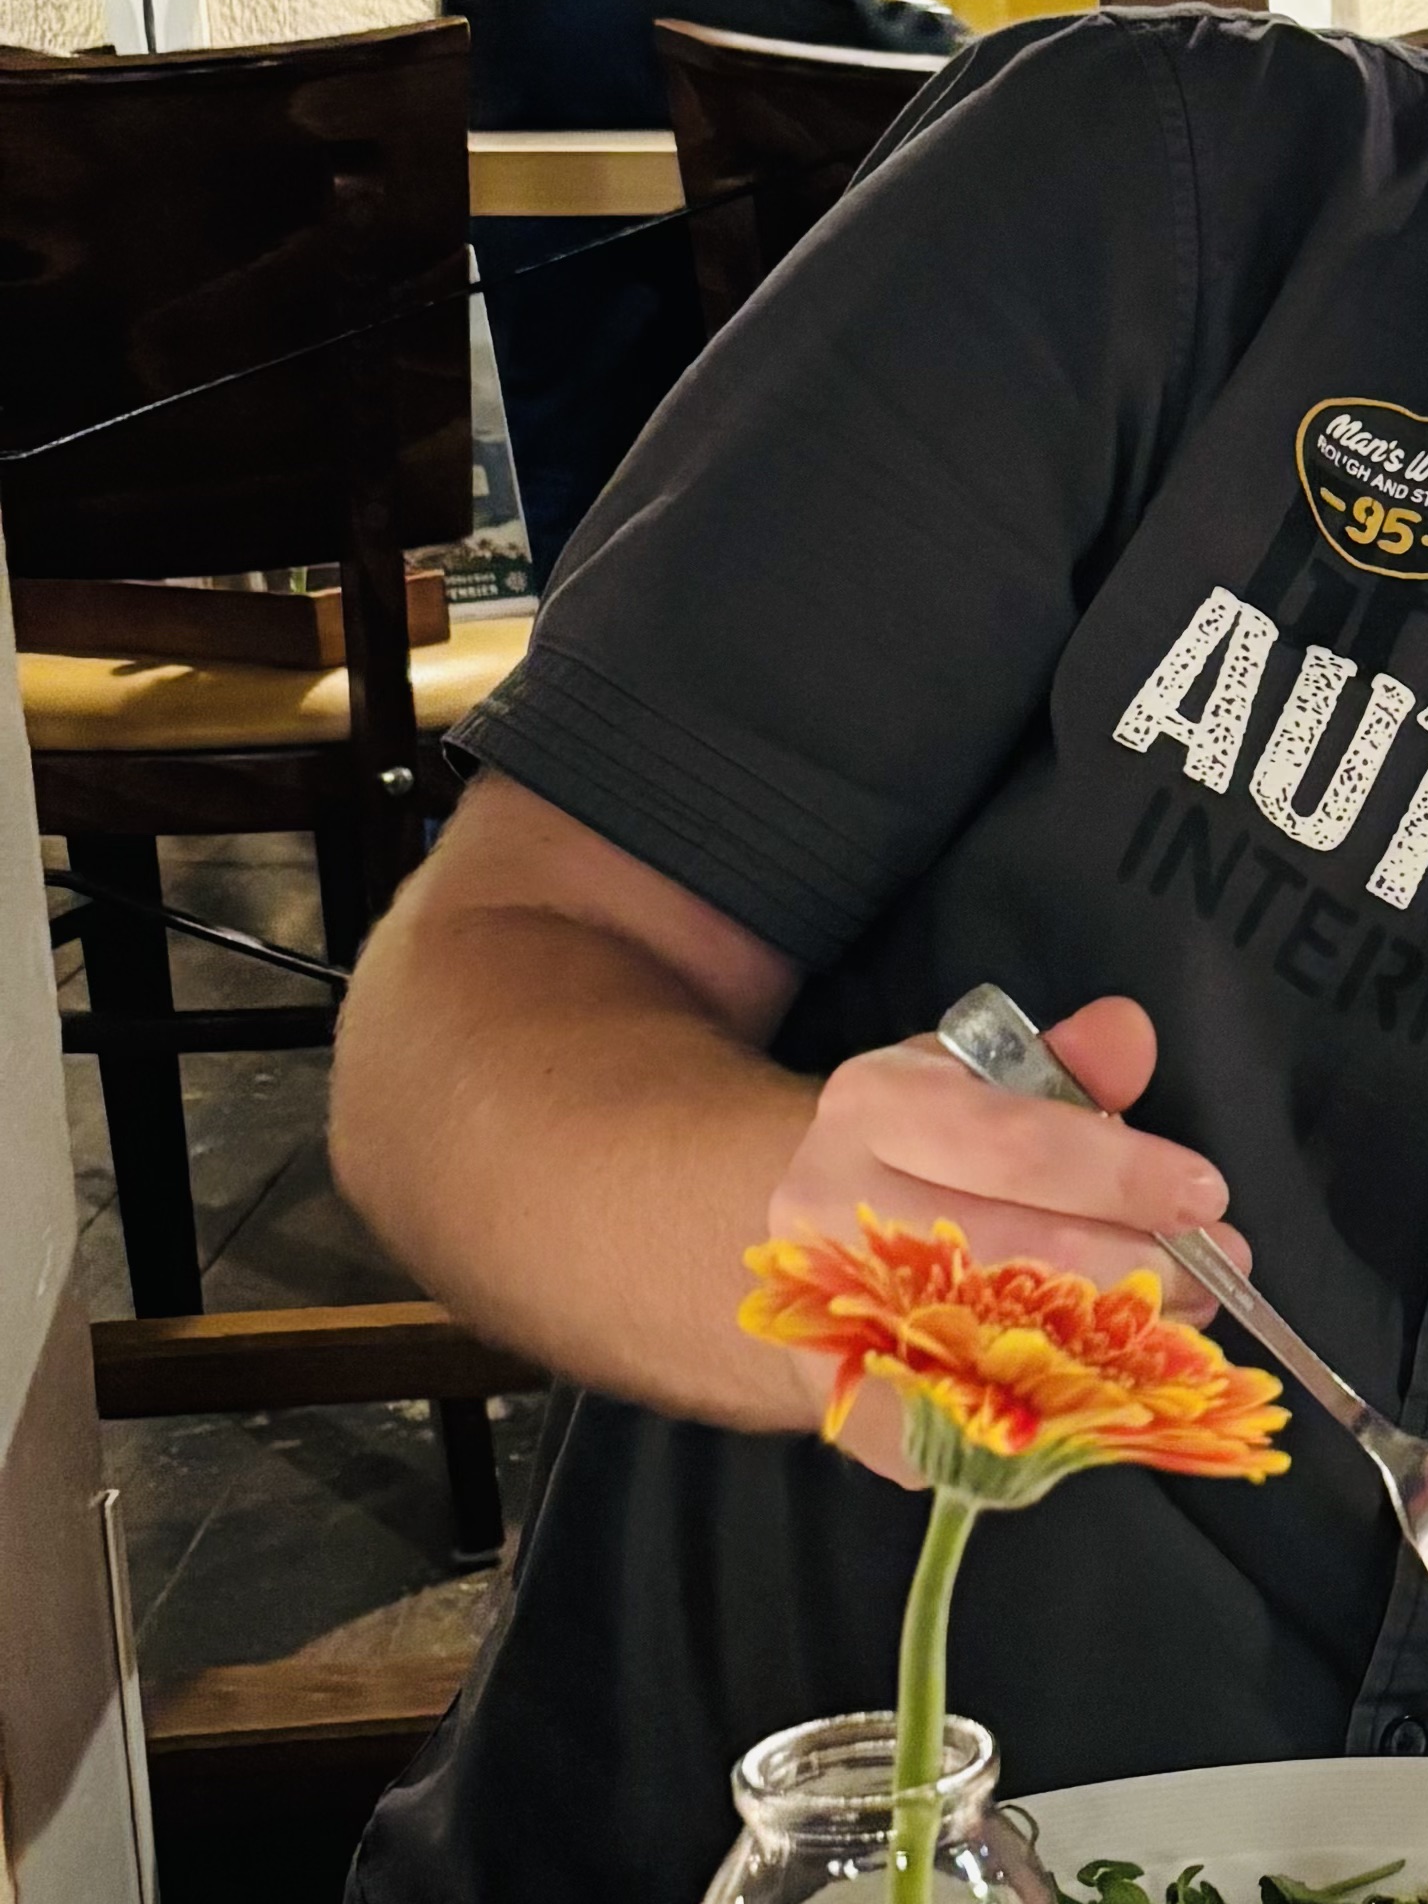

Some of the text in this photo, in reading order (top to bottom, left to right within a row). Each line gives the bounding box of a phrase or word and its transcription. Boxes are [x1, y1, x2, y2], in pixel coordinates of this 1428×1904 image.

[1317, 434, 1372, 482] ROUGH
[1370, 472, 1410, 500] AND
[1325, 413, 1405, 473] Man's
